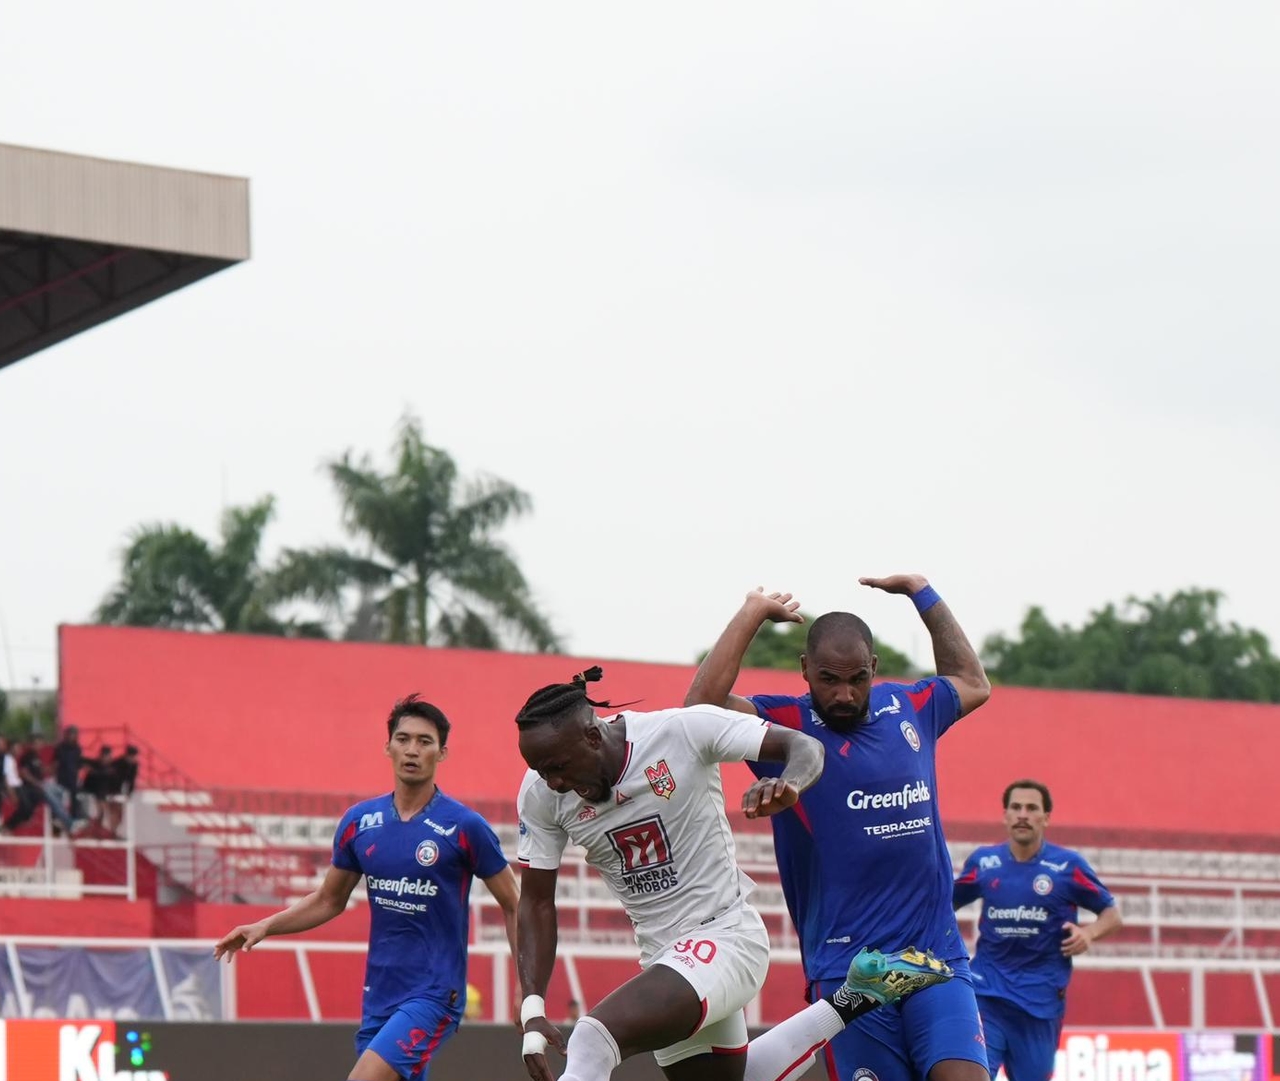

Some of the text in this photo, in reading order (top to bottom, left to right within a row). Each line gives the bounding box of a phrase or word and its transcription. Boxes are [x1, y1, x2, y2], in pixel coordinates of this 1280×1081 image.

[846, 780, 931, 810] Greenfields
[863, 817, 932, 836] TERRAZONE
[622, 866, 678, 886] MINERAL
[628, 876, 678, 894] TROBOS
[367, 876, 438, 897] Greenfields
[375, 896, 427, 912] TERRAZONE
[987, 905, 1049, 922] Greenfields
